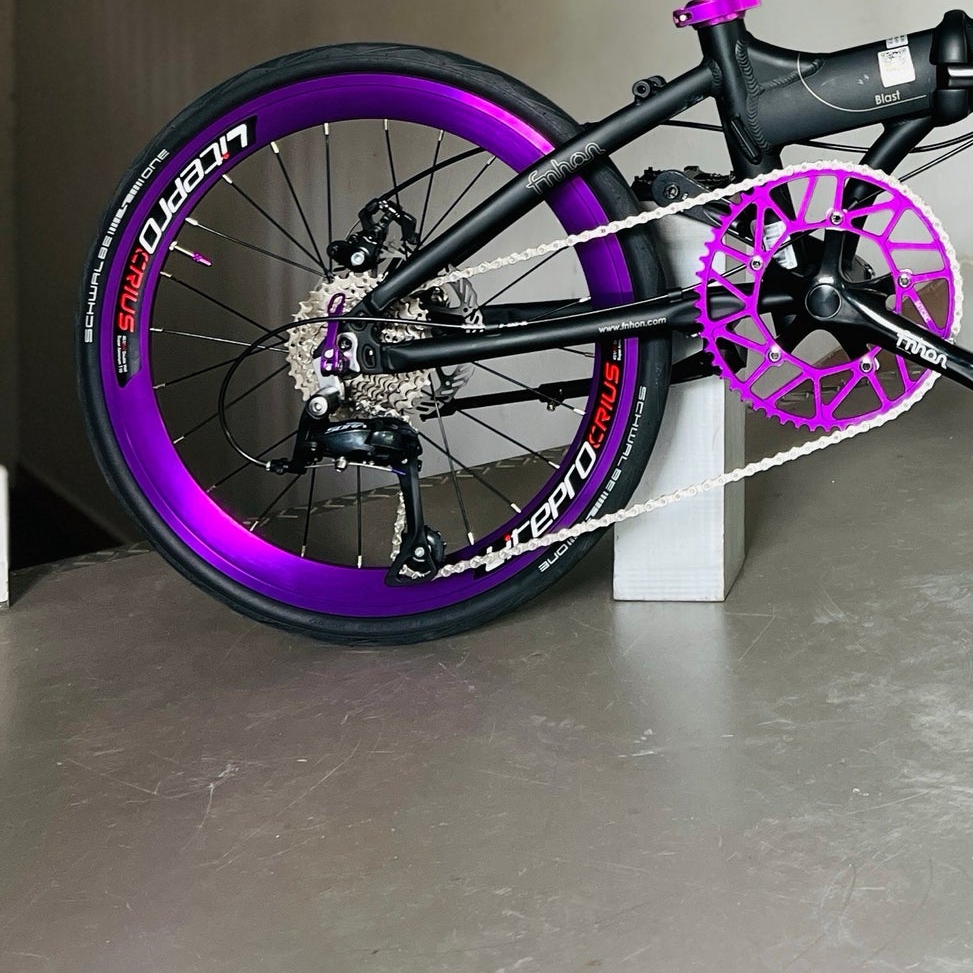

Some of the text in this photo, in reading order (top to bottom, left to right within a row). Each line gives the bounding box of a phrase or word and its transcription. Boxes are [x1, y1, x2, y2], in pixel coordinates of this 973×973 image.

[875, 90, 901, 106] Blast
[526, 142, 606, 195] fnhon
[84, 234, 114, 343] SCHWALBE
[117, 247, 149, 333] CRIUS
[598, 316, 667, 335] www.fnhon.com
[586, 362, 620, 449] CRIUS
[603, 385, 647, 493] SCHWALBE
